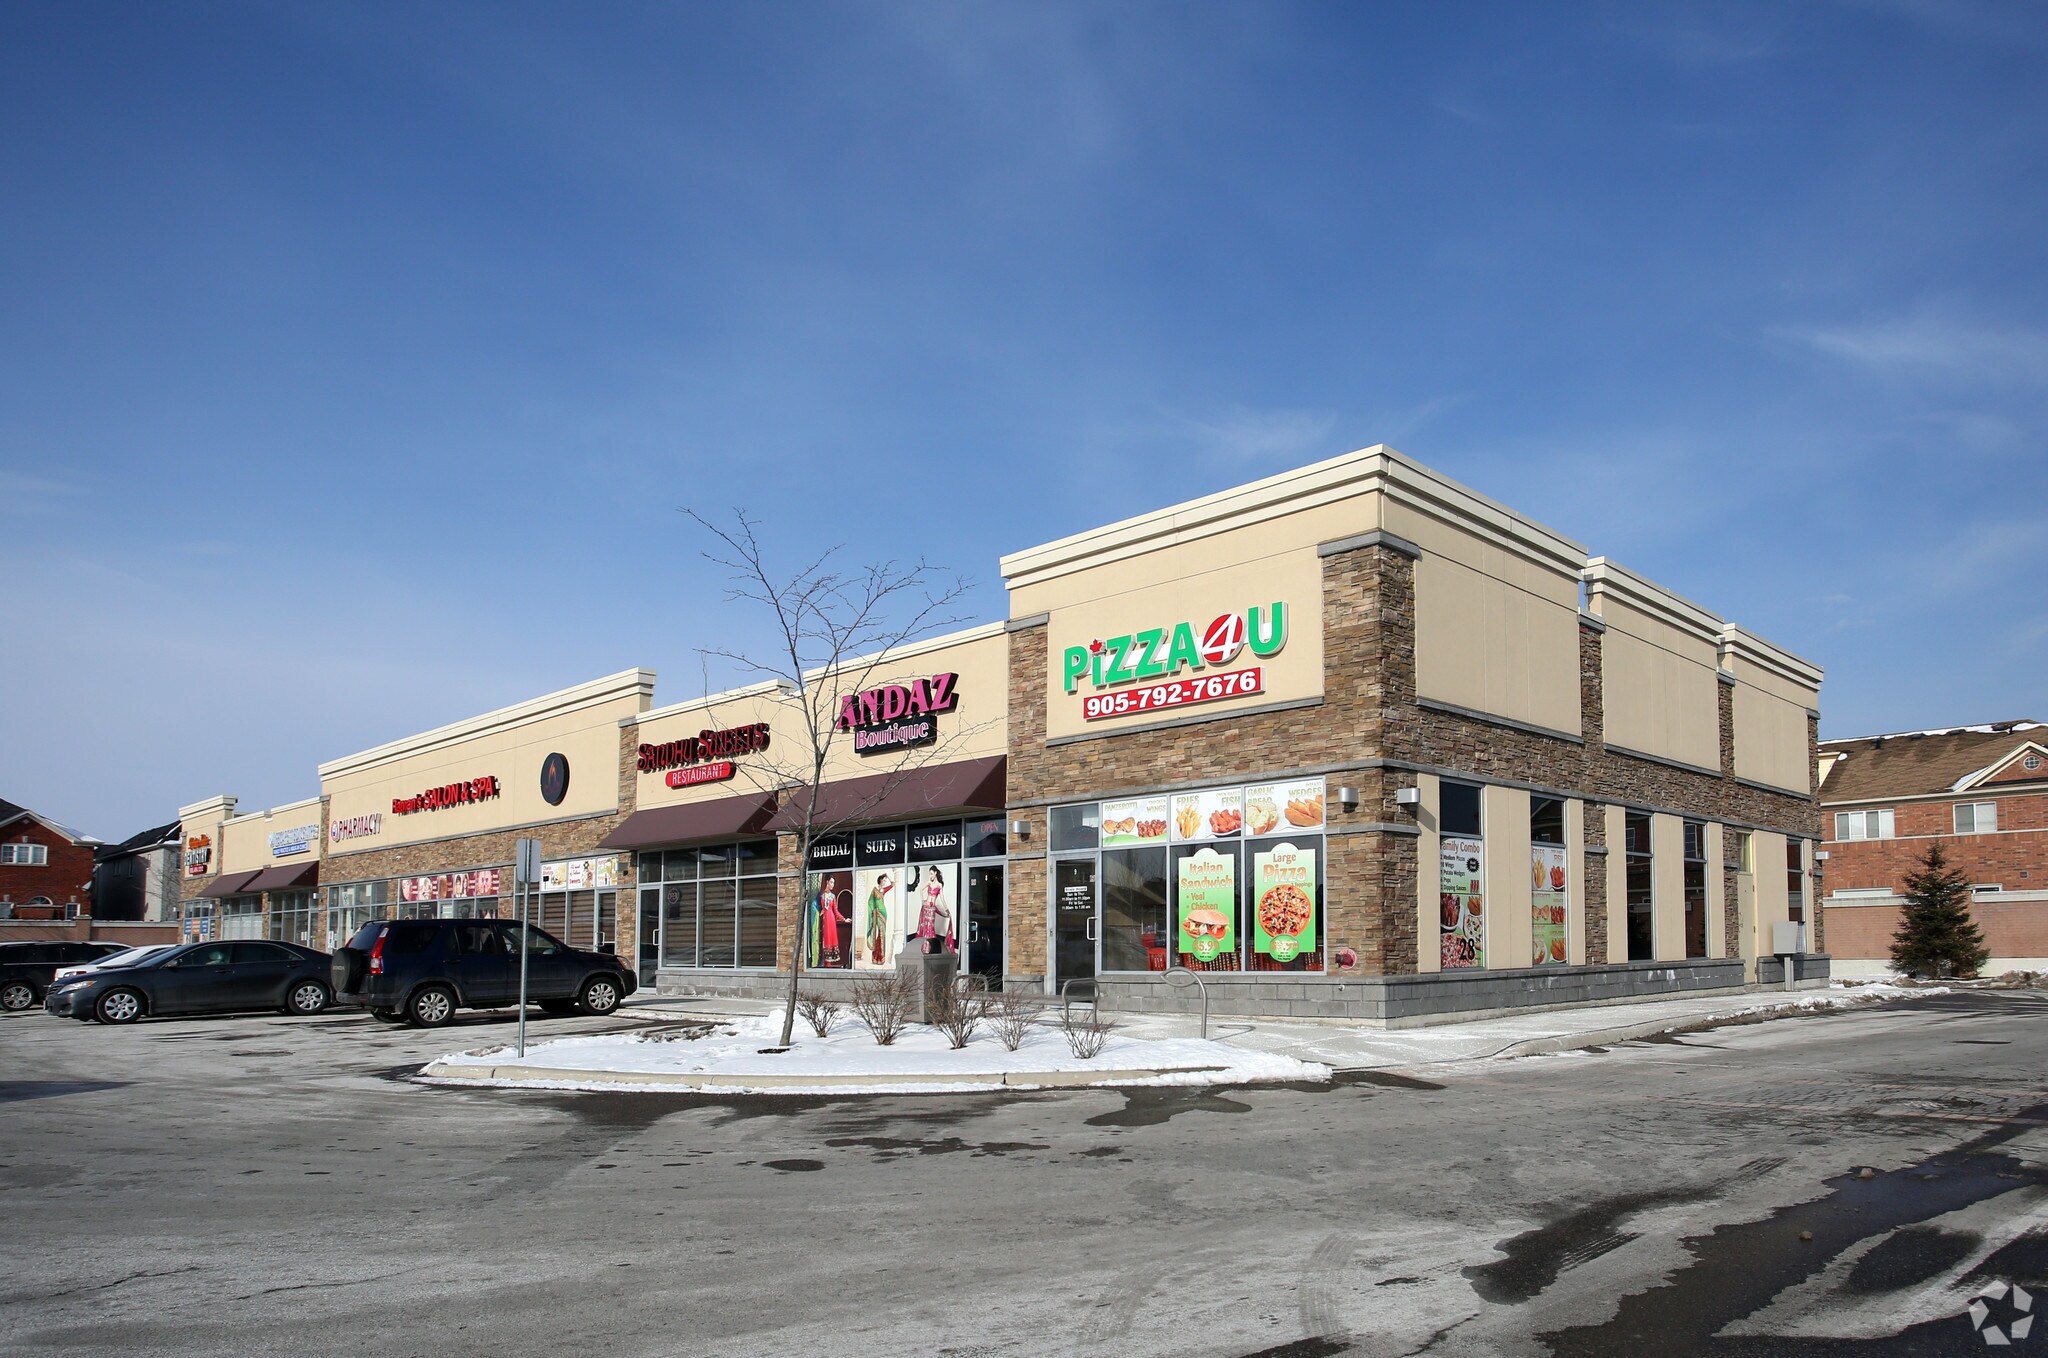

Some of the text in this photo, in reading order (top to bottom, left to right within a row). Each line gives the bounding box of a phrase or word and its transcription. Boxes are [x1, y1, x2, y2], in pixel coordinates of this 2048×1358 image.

[1087, 671, 1256, 716] 905-792-7676
[836, 672, 955, 729] ANDAZ
[856, 722, 929, 749] Boutique
[637, 722, 767, 770] SANDHU SWEETS
[672, 764, 724, 784] RESTAURANT
[423, 782, 459, 809] SALON
[460, 781, 469, 801] &
[471, 776, 494, 799] SPA
[1248, 787, 1274, 796] GARLIC
[1289, 787, 1322, 798] WEDGES
[1177, 795, 1200, 805] FRIES
[1222, 796, 1240, 805] FISH
[1147, 805, 1166, 813] WINGS
[981, 823, 998, 833] OPEN
[813, 833, 957, 858] BRIDAL SUITS SAREES
[1460, 841, 1480, 854] Combo
[1273, 853, 1297, 864] Large
[1190, 862, 1223, 874] Italian
[1264, 864, 1307, 882] Pizza
[1181, 875, 1233, 889] Sandwich
[1191, 892, 1205, 901] Veal
[1191, 902, 1219, 911] Chicken
[1459, 937, 1476, 960] 28
